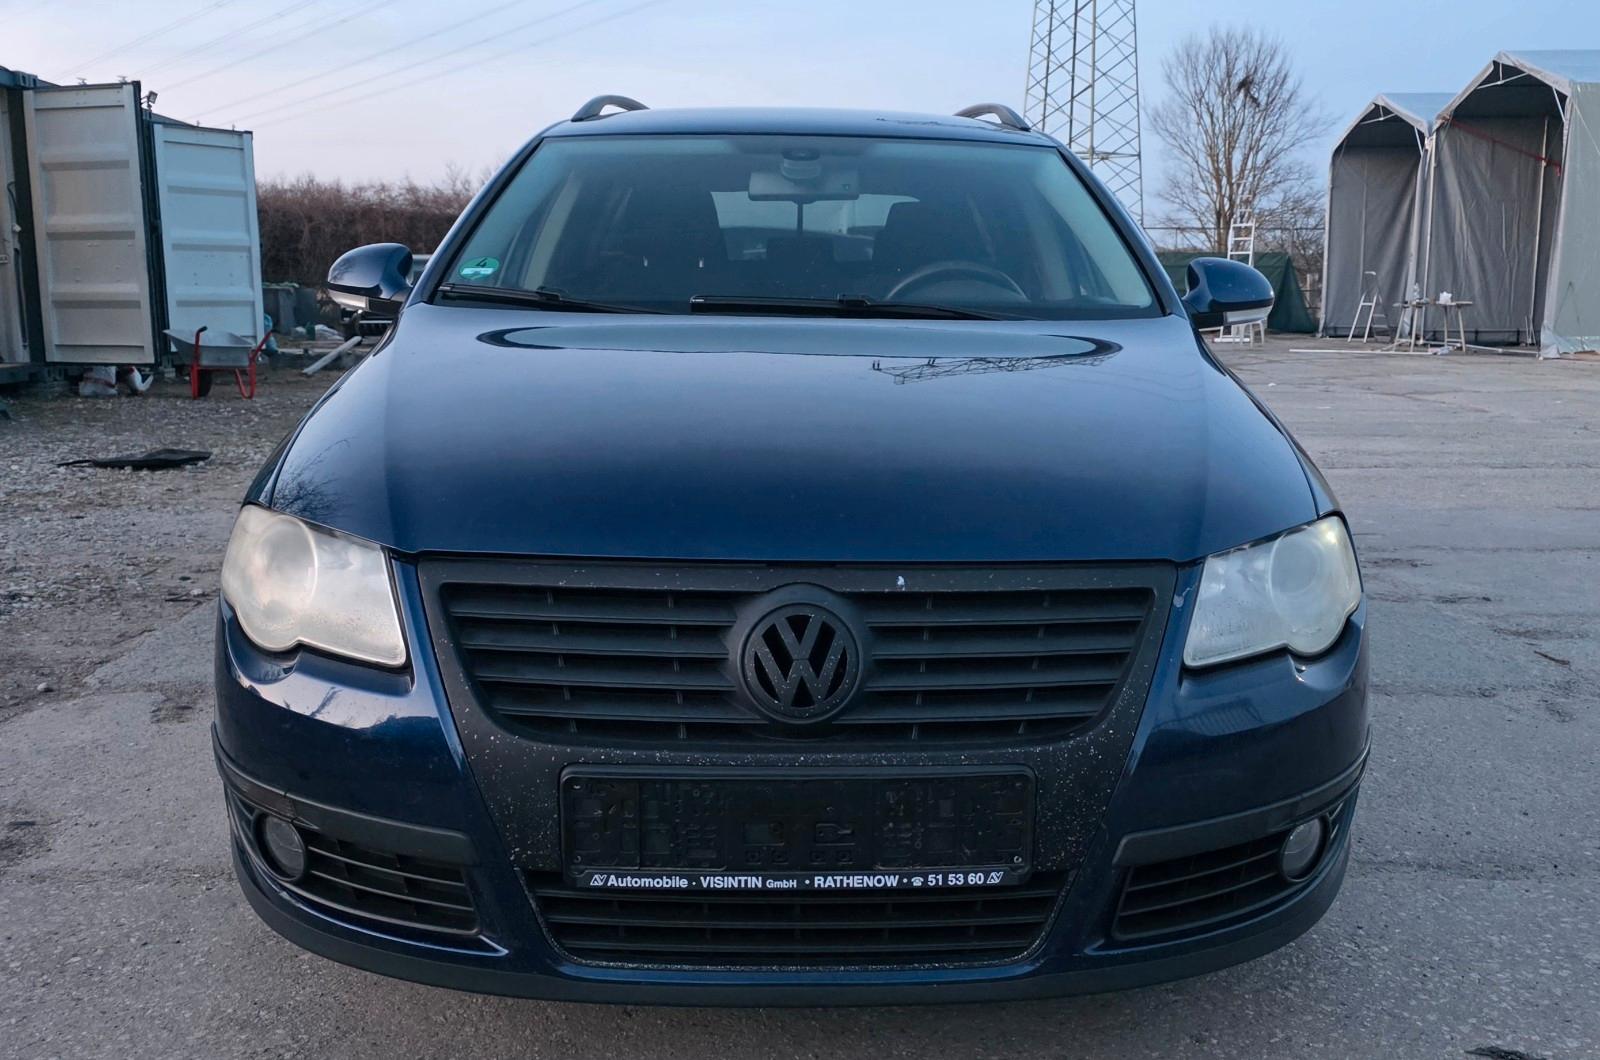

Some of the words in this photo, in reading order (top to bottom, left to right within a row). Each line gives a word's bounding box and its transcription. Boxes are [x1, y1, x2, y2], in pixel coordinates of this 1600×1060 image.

[475, 257, 488, 268] 4
[746, 604, 858, 716] VW
[608, 875, 688, 888] Automobile
[700, 876, 762, 888] VISINTIN
[766, 879, 797, 888] GmbH
[814, 875, 899, 888] RATHENOW
[927, 873, 942, 886] 51
[947, 873, 964, 886] 53
[967, 872, 984, 885] 60
